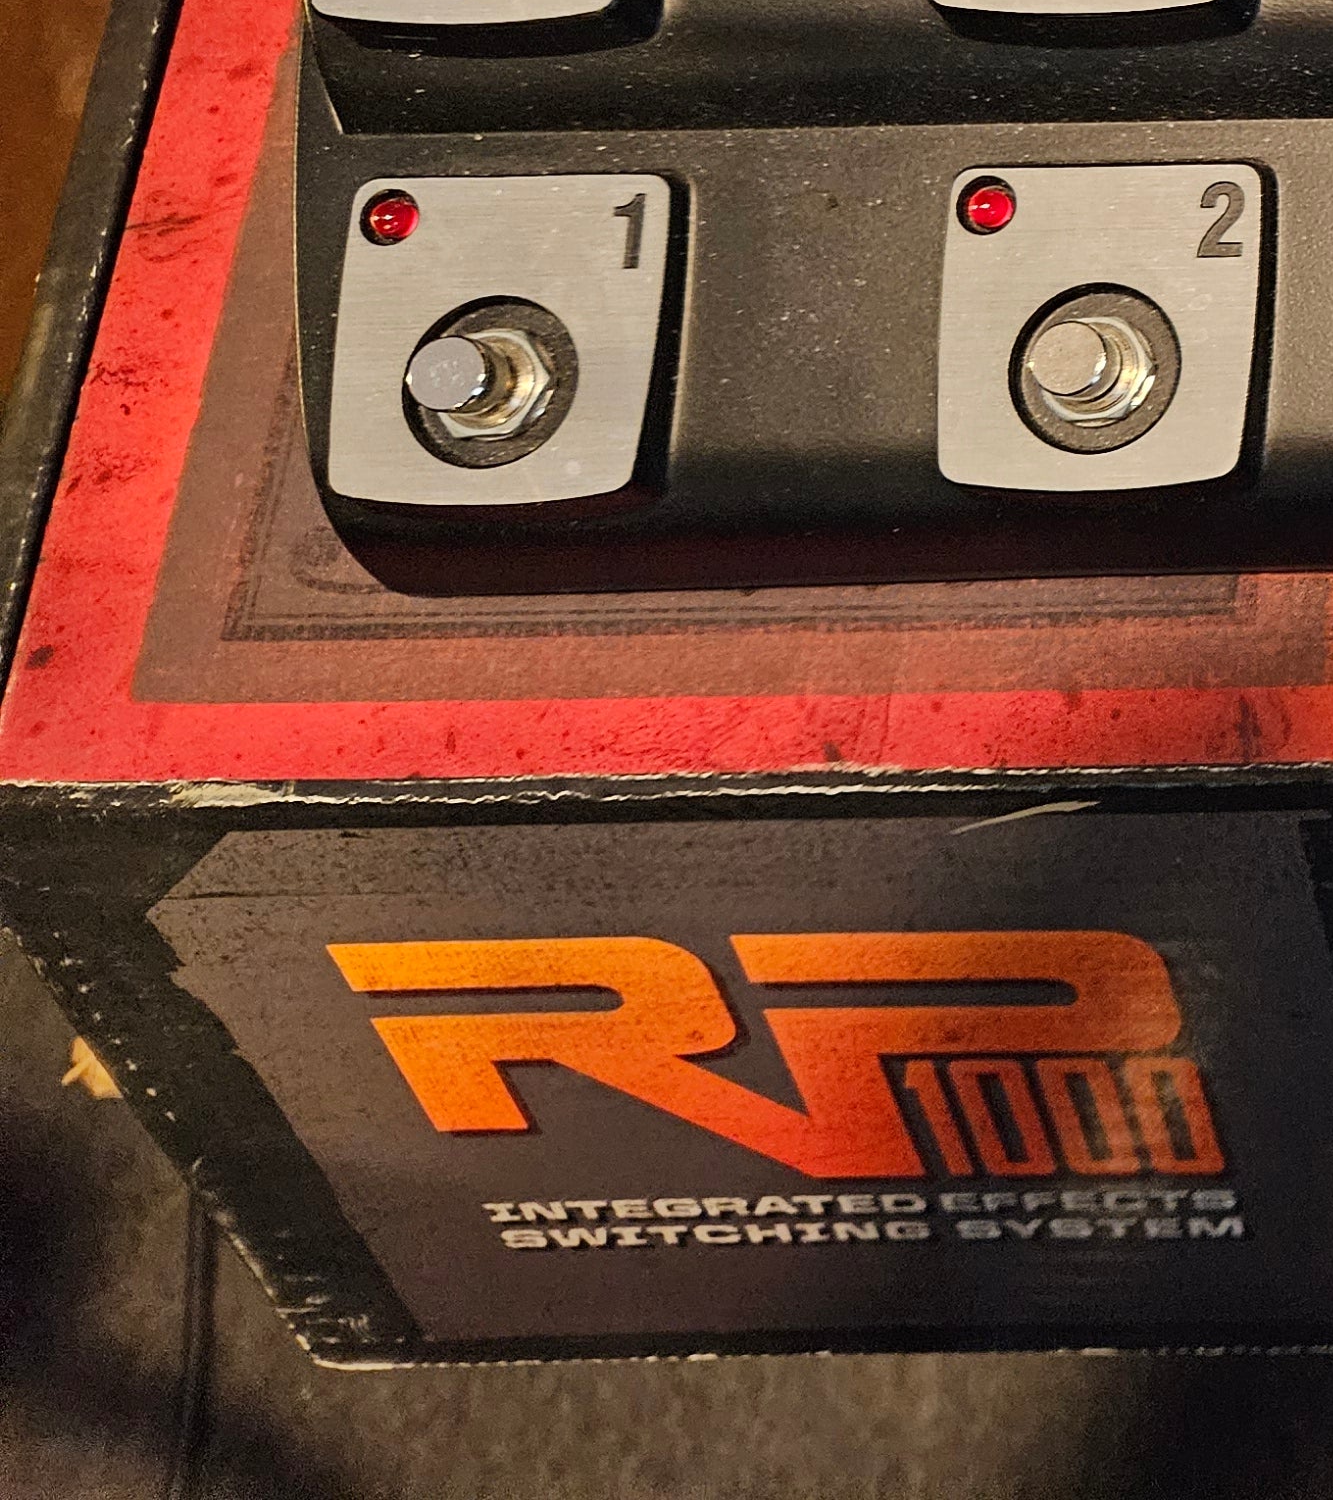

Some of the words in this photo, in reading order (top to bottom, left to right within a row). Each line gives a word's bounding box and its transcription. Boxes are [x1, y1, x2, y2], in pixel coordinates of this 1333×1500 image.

[612, 193, 647, 270] 1
[1197, 182, 1244, 259] 2
[483, 1194, 927, 1222] INTEGRATED
[941, 1189, 1237, 1214] EFFECTS
[501, 1219, 931, 1248] SWITCHING
[957, 1217, 1246, 1239] SYSTEM
